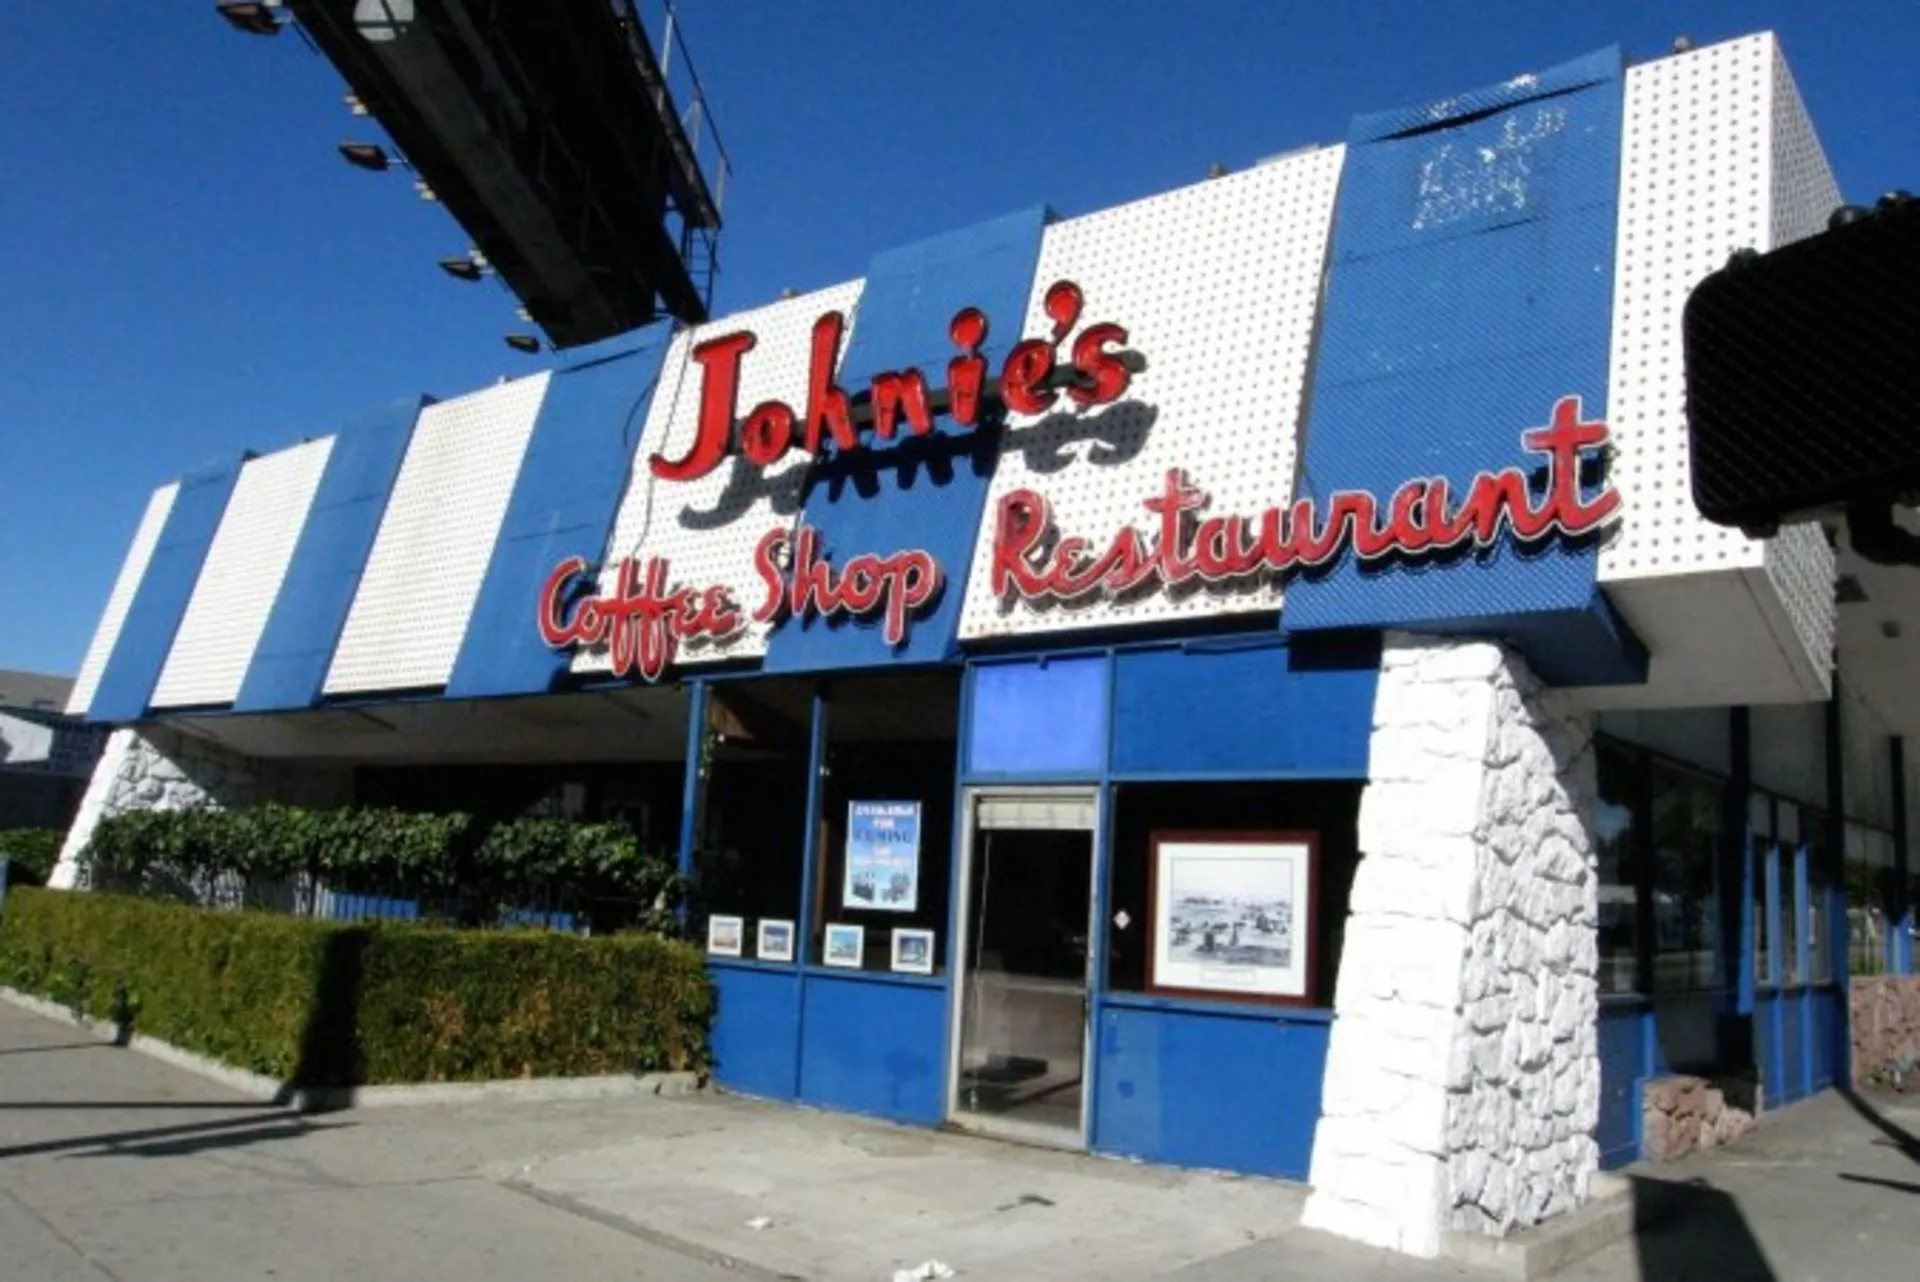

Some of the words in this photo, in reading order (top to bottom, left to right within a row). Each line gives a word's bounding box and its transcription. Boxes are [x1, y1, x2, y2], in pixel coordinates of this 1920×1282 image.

[650, 281, 1131, 481] Johnie's
[538, 556, 740, 682] Coffee
[753, 526, 941, 645] Shop
[993, 395, 1623, 596] Restaurant
